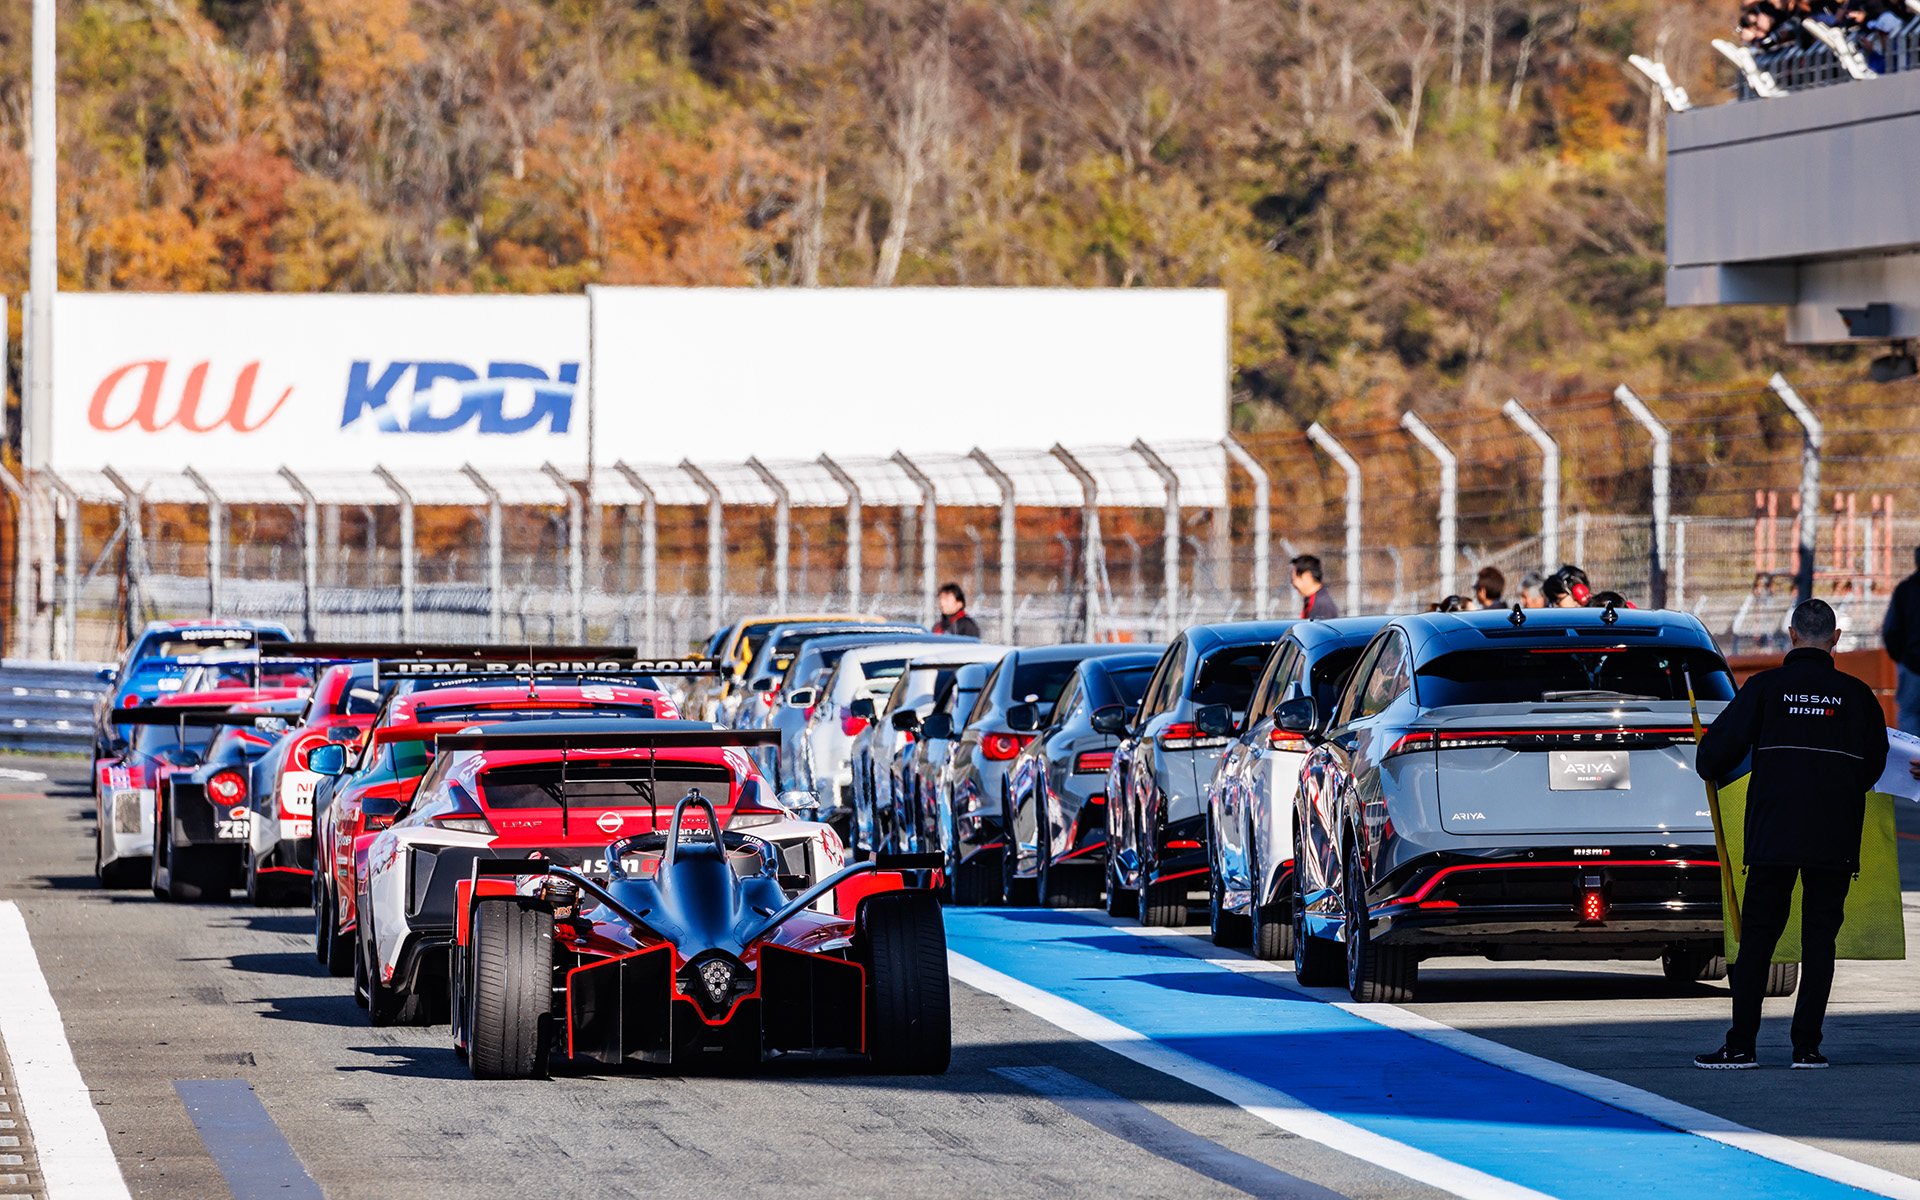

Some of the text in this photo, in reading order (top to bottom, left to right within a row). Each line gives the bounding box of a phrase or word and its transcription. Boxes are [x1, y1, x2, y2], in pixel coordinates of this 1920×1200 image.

[87, 359, 294, 433] au
[339, 360, 580, 434] KDDI
[1783, 694, 1842, 705] NISSAN
[1788, 706, 1834, 716] nismo
[1535, 733, 1645, 742] NISSAN
[1564, 763, 1615, 774] ARIYA
[1451, 812, 1487, 821] ARIYA
